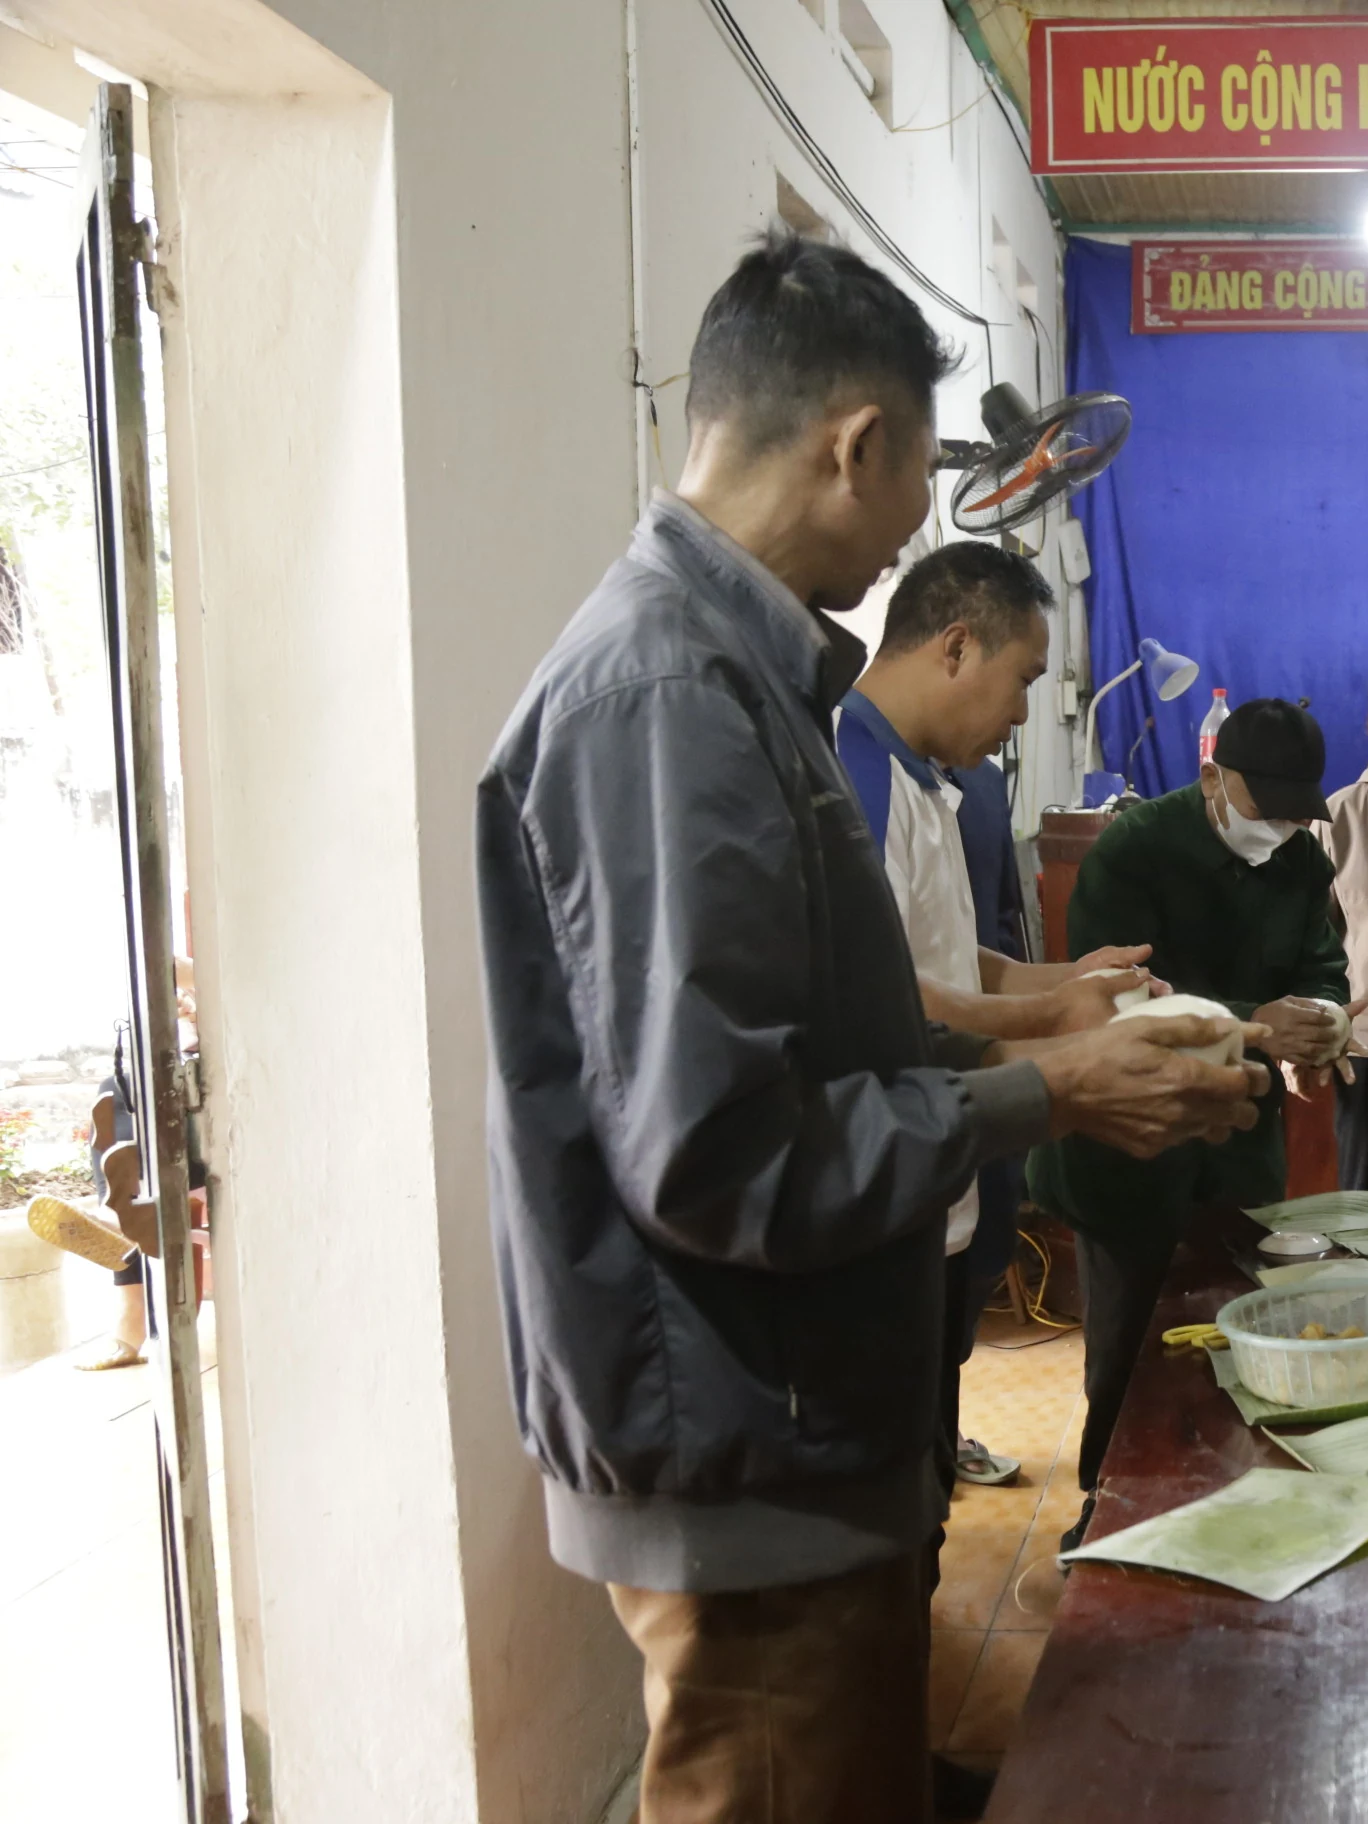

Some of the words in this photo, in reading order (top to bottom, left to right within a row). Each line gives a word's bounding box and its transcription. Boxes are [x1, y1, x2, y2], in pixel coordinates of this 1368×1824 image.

[1083, 45, 1206, 134] NƯỚC
[1221, 49, 1343, 146] CỘNG
[1170, 254, 1263, 310] ĐẢNG
[1274, 263, 1366, 318] CỘNG
